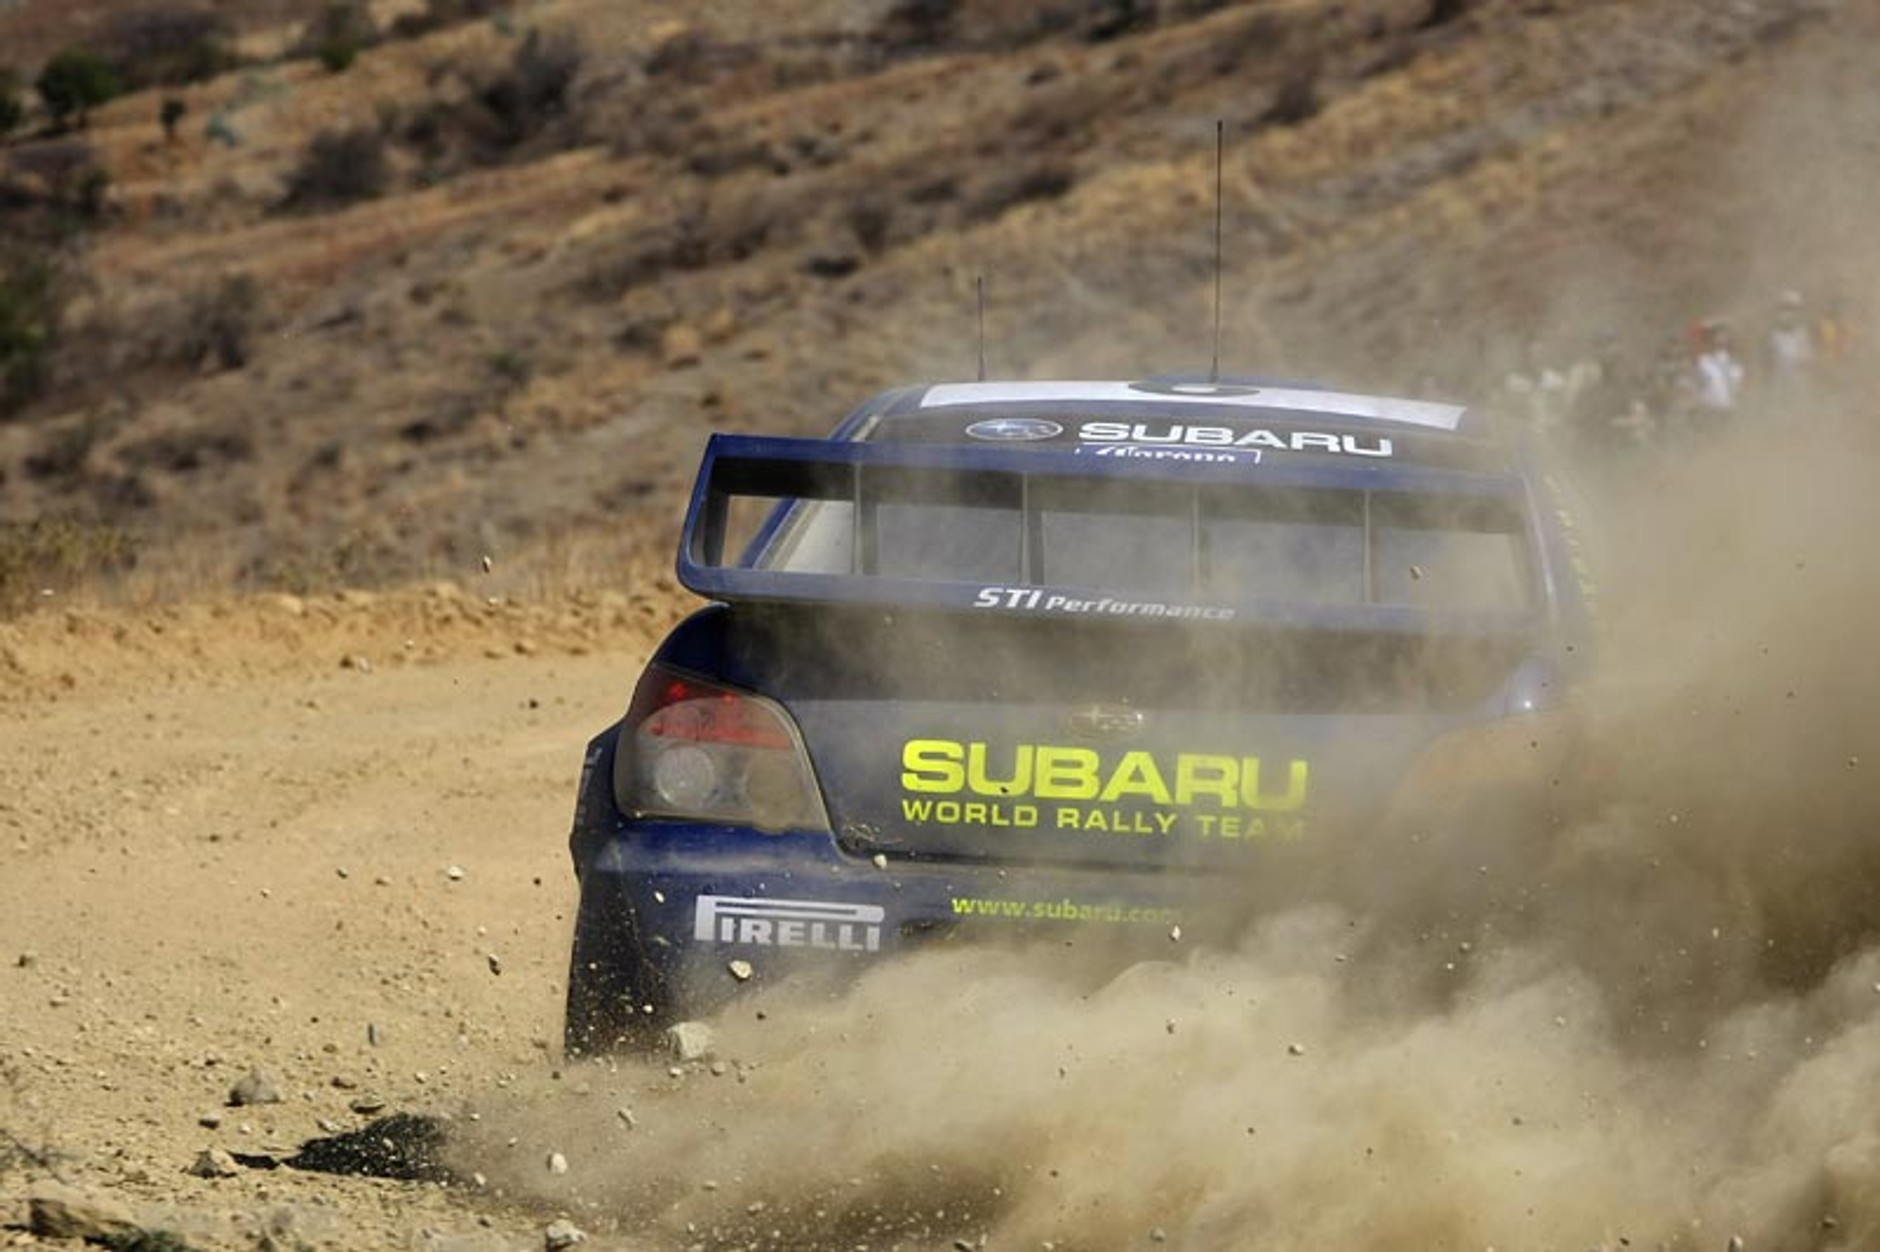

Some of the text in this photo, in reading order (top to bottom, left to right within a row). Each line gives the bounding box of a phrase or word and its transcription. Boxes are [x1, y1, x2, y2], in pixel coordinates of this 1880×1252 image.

[1079, 422, 1393, 457] SUBARU
[973, 587, 1236, 620] STI Performance
[902, 739, 1308, 811] SUBARU
[902, 800, 1038, 827] WORLD
[1057, 808, 1178, 834] RALLY
[694, 894, 885, 951] PIRELLI
